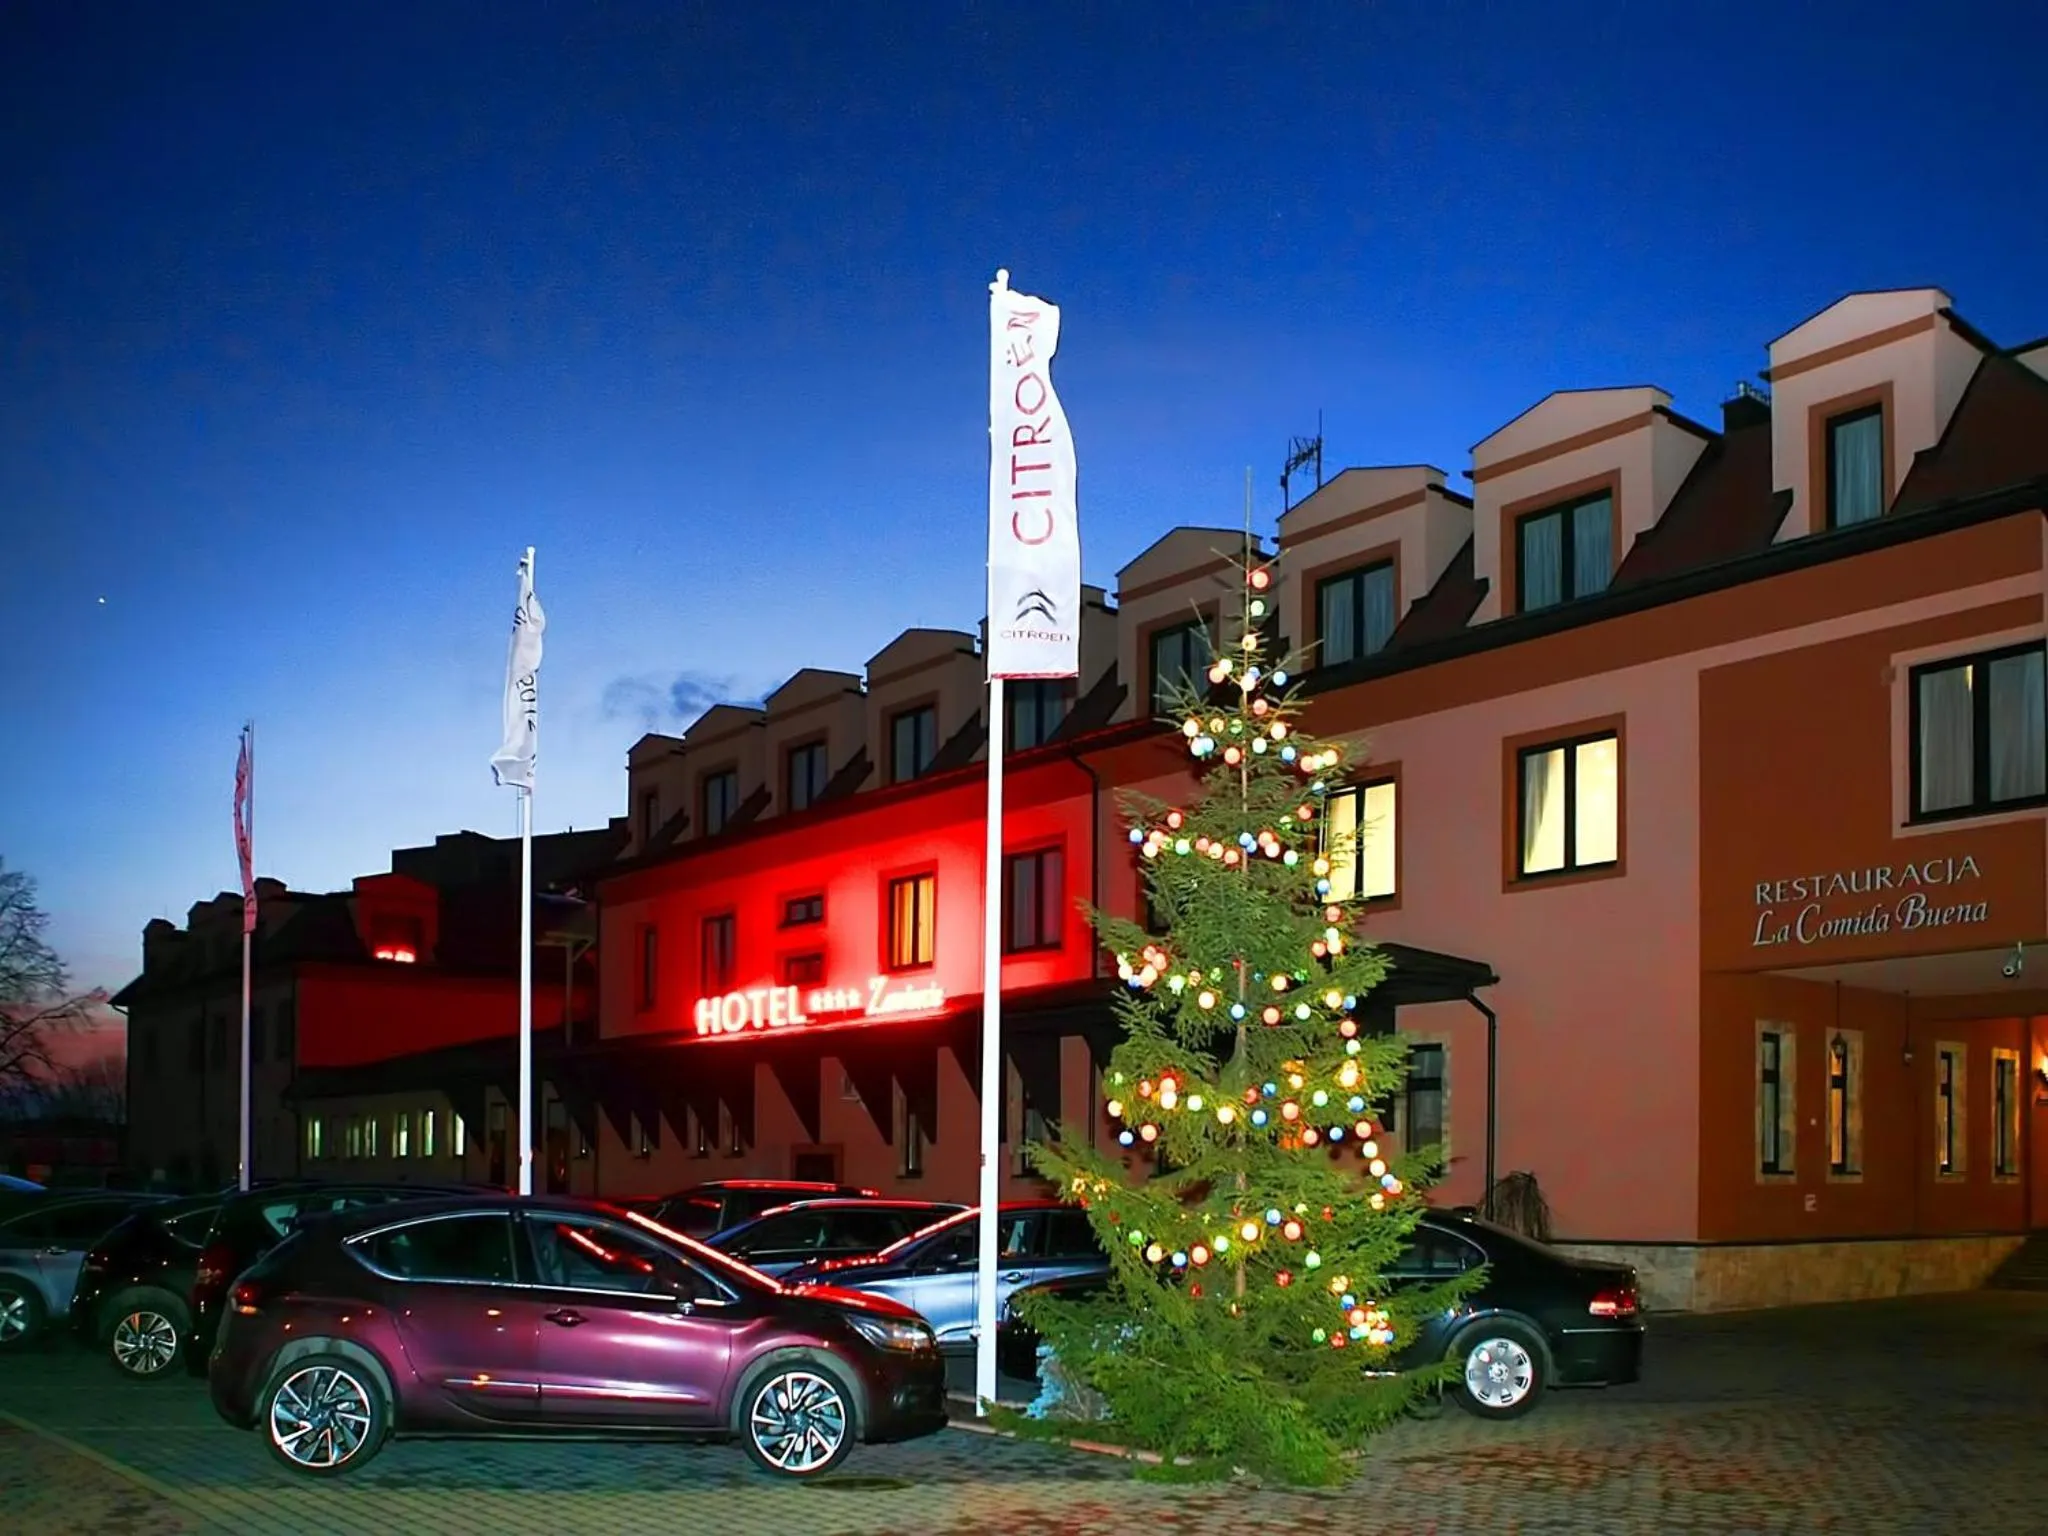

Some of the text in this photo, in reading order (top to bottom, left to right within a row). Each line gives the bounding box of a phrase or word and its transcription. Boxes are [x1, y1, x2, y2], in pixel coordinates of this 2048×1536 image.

[1756, 855, 1981, 905] RESTAURACJA
[1753, 892, 1988, 946] La Comida Buena
[695, 985, 807, 1035] HOTEL
